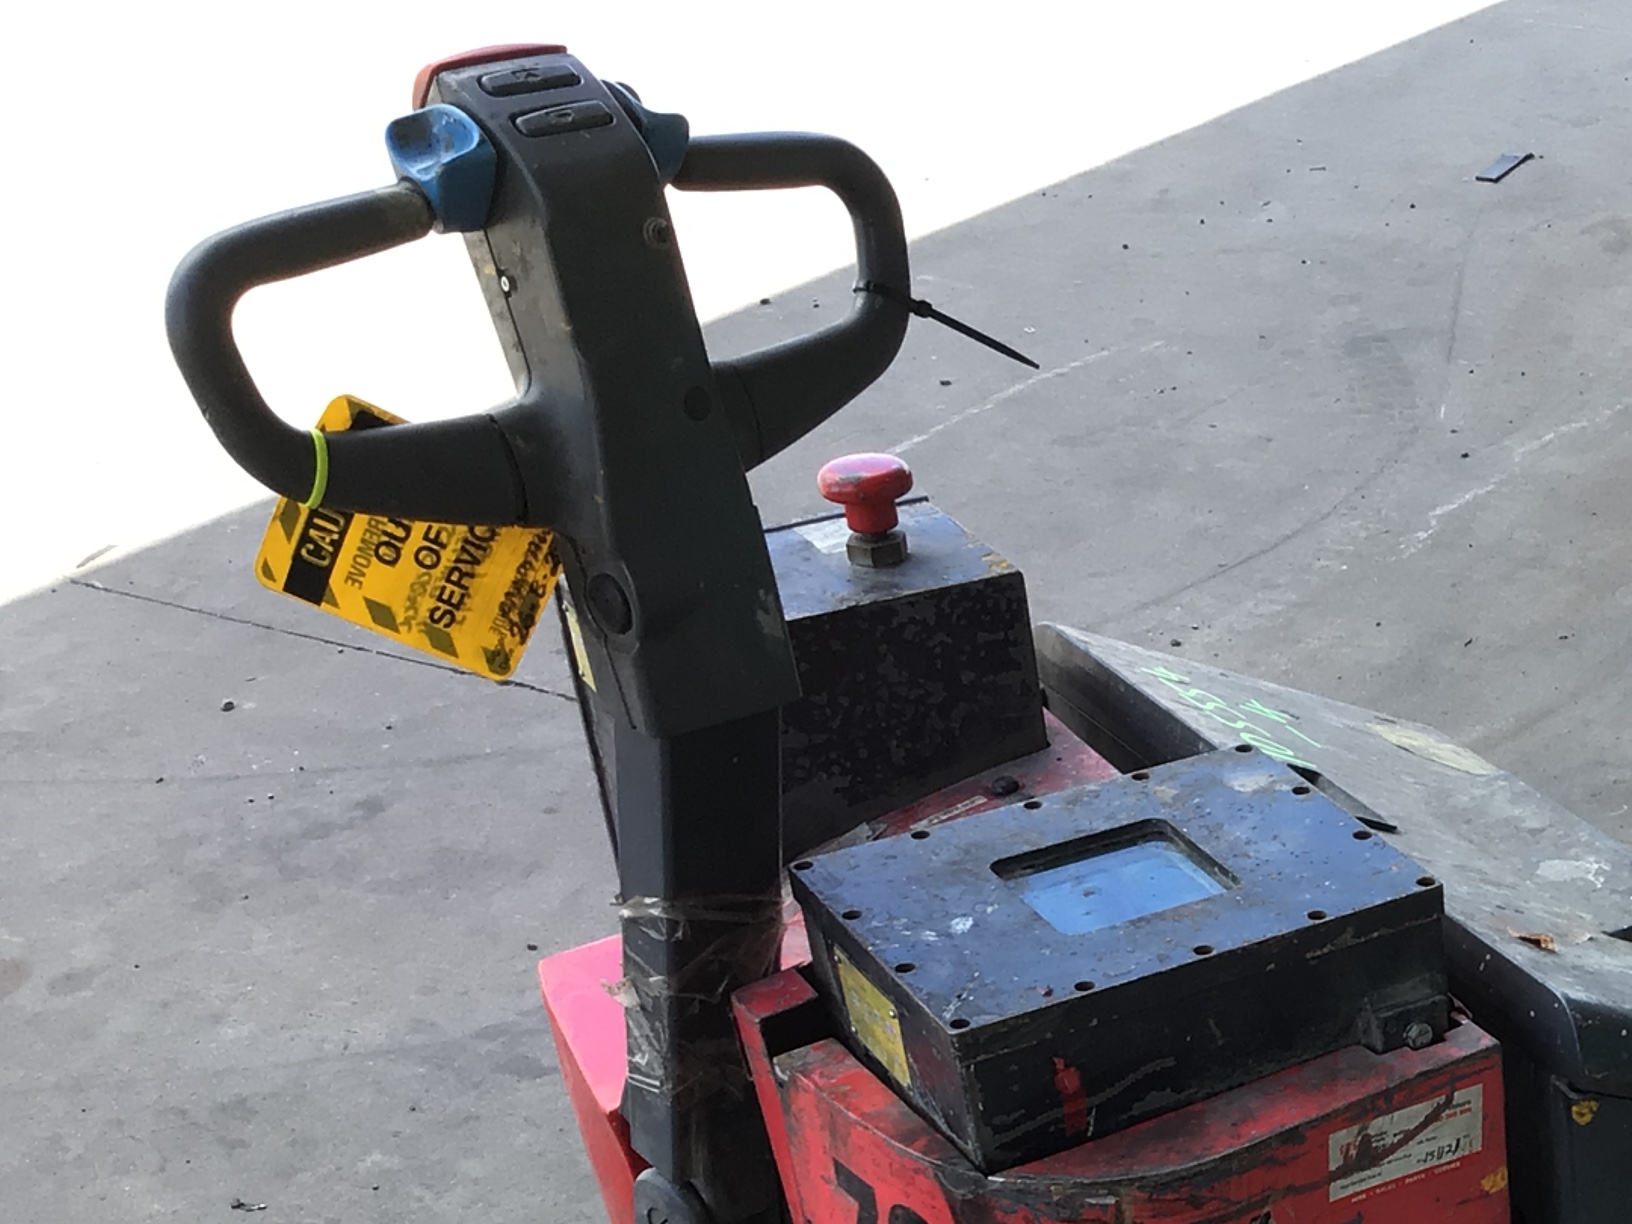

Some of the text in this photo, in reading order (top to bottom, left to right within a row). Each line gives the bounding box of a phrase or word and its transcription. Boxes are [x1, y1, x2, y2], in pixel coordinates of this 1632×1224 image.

[373, 517, 413, 568] OU
[413, 523, 450, 571] OF
[428, 524, 498, 630] SERVIC
